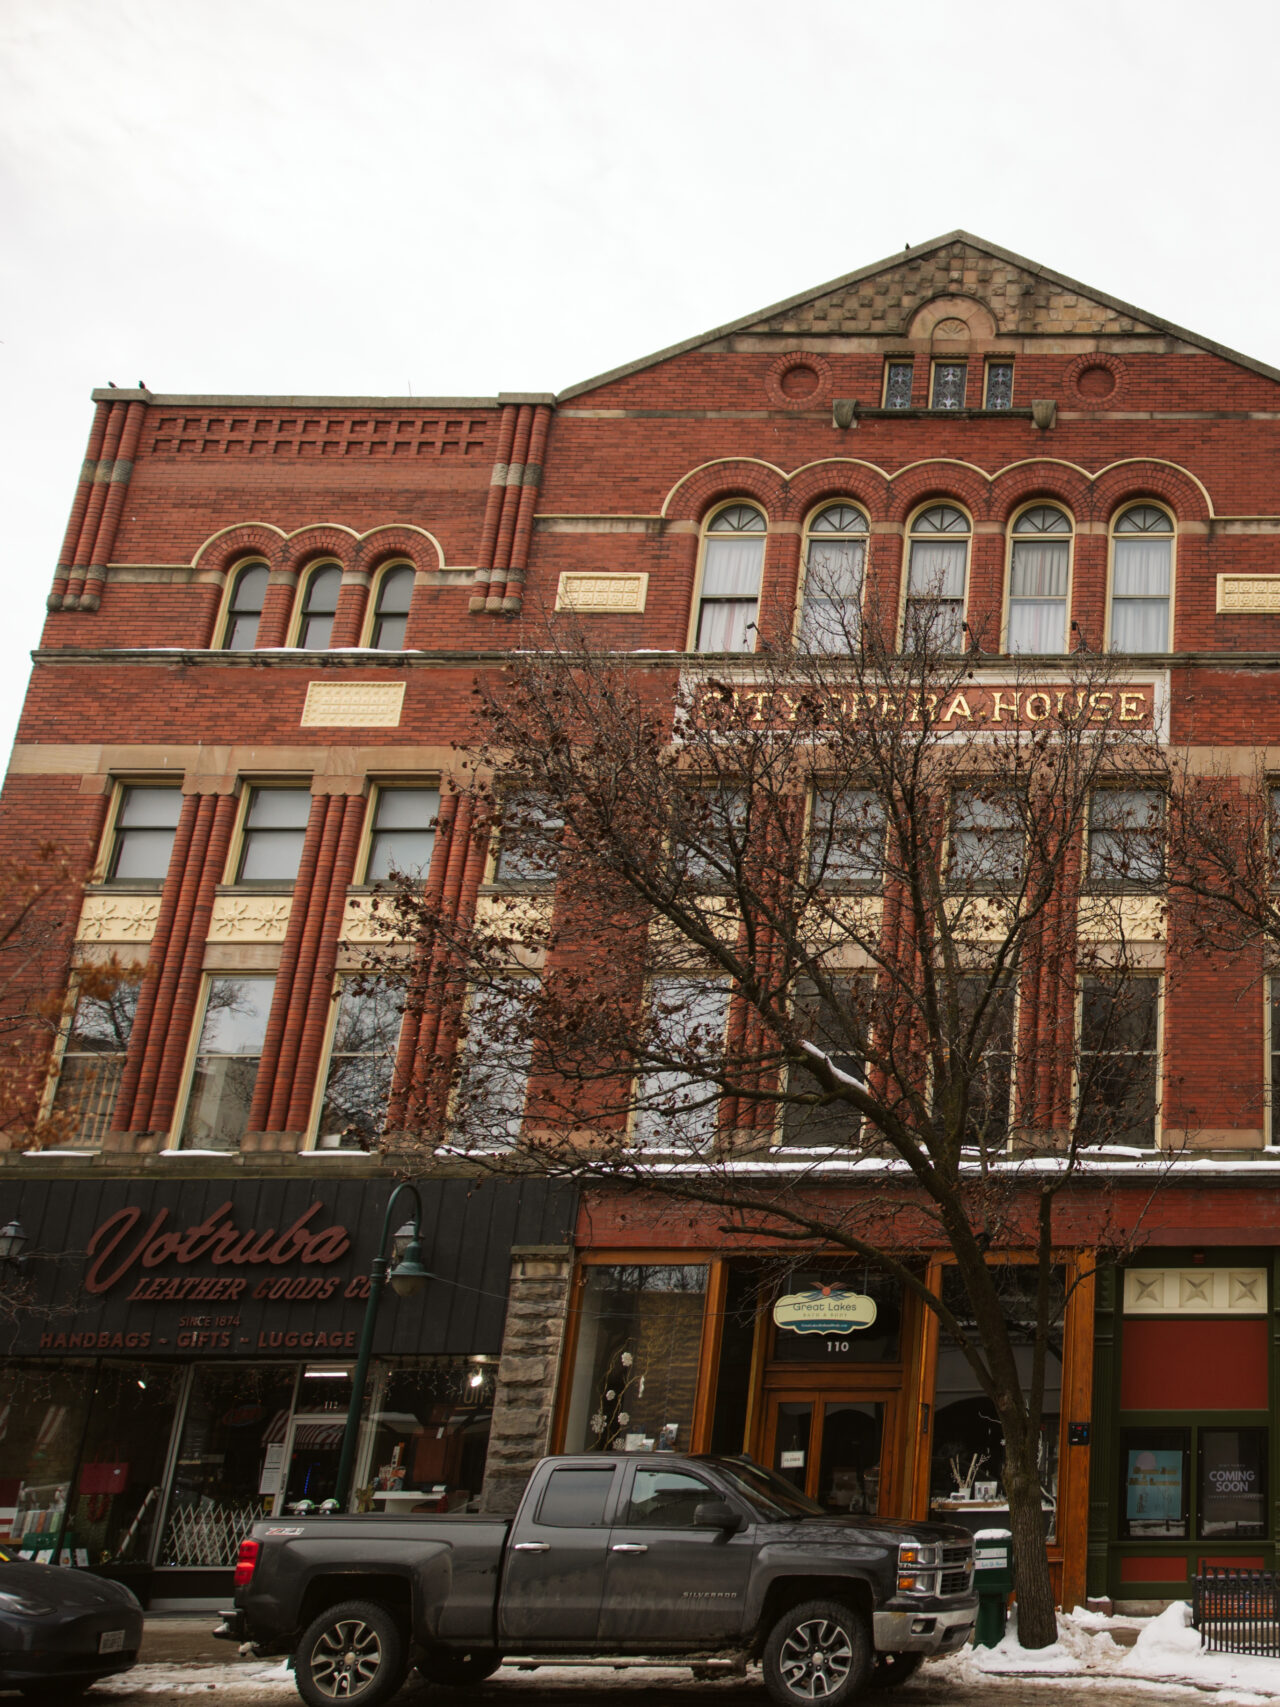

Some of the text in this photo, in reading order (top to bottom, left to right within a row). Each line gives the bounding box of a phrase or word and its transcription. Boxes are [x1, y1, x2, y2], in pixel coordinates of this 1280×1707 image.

[991, 691, 1148, 722] HOUSE
[85, 1200, 351, 1294] Votruba
[125, 1277, 248, 1301] LEATHER
[252, 1276, 342, 1300] GOODS
[793, 1302, 857, 1312] Great Lakes
[179, 1314, 241, 1328] SINCE 1874
[40, 1330, 356, 1349] HANDBAGS GIFTS LUGGAGE
[827, 1341, 849, 1352] 110
[324, 1400, 339, 1409] 112
[1208, 1470, 1256, 1481] COMING
[1215, 1481, 1249, 1492] SOON
